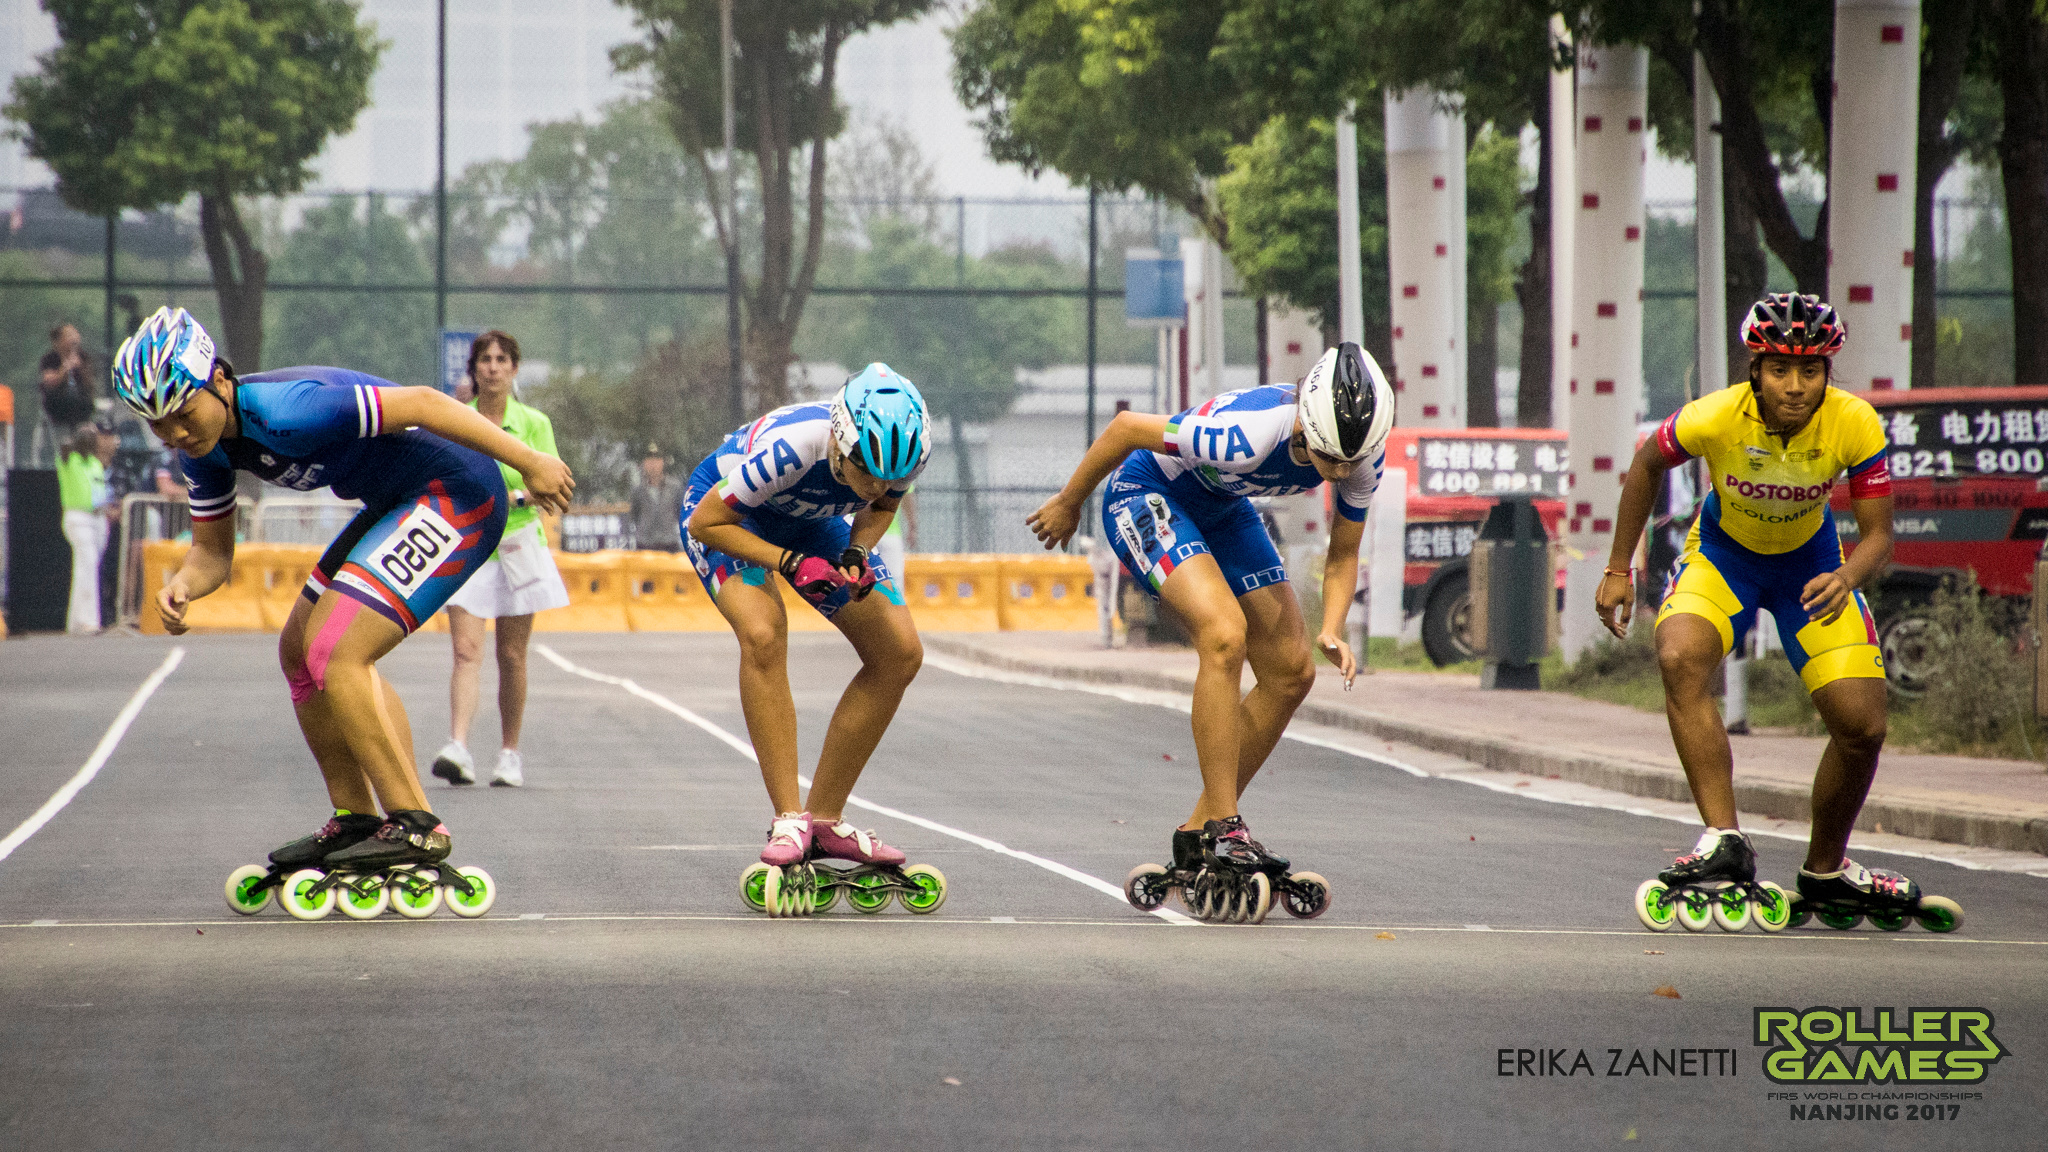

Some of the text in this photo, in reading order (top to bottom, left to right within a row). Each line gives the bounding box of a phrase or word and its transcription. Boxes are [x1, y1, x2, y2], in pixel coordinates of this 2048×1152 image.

[1193, 424, 1256, 462] ITA
[742, 438, 804, 493] ITA
[1892, 448, 2045, 478] 821 800
[1427, 471, 1480, 493] 400
[1726, 474, 1833, 502] POSTOBON
[1731, 502, 1822, 524] COLOMBIA
[380, 518, 452, 587] 1020
